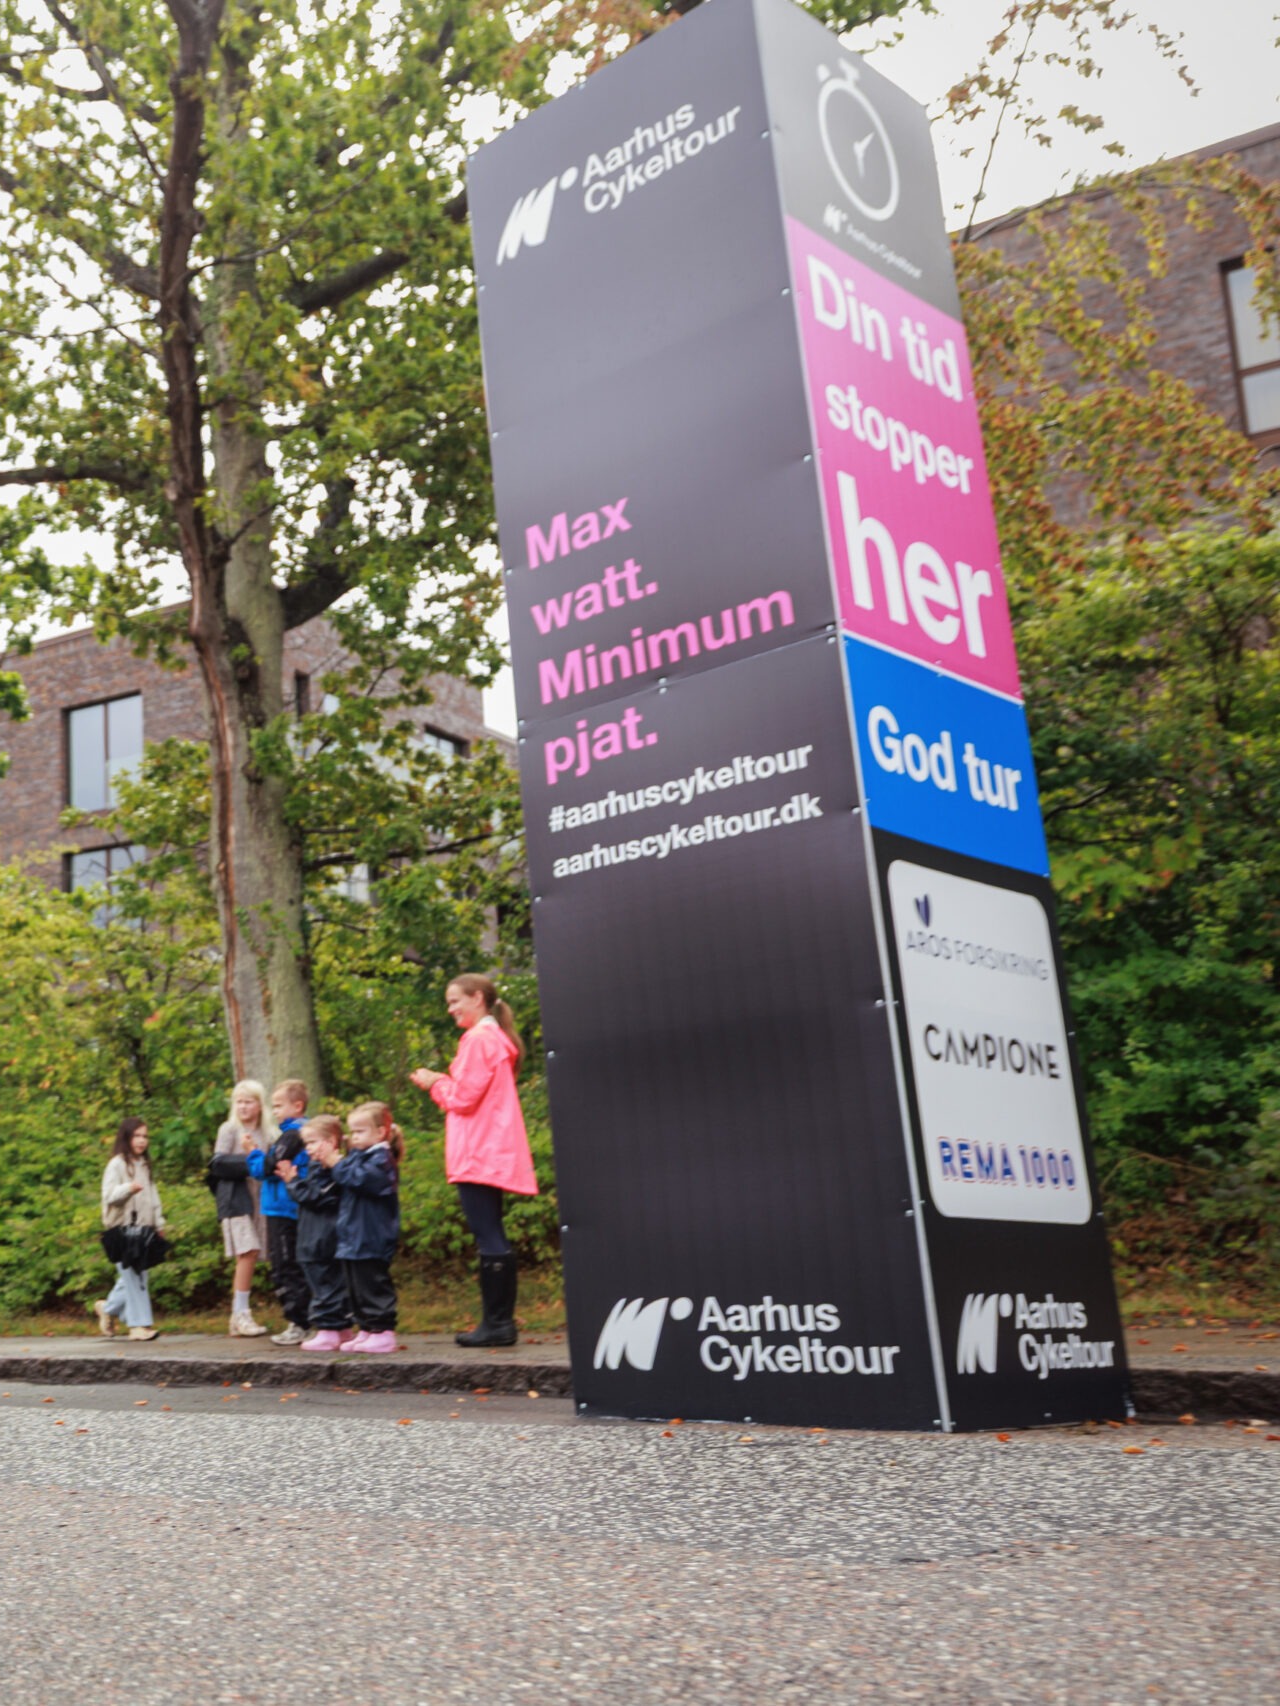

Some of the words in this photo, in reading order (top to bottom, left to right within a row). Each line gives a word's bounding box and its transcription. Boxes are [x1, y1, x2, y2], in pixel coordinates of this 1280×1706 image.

[582, 103, 695, 188] Aarhus
[584, 105, 741, 214] Cykeltour
[807, 254, 893, 362] Din
[900, 315, 964, 402] tid
[825, 384, 974, 494] stopper
[525, 497, 632, 570] Max
[837, 470, 993, 659] her
[530, 558, 659, 635] watt.
[538, 590, 795, 705] Minimum
[544, 706, 658, 786] pjat.
[867, 705, 958, 793] God
[963, 743, 1022, 811] tur
[548, 744, 814, 833] #aarhuscykeltour
[552, 793, 823, 878] aarhuscykeltour.dk
[906, 930, 953, 961] AROS
[924, 1023, 1061, 1079] CAMPIONE
[936, 1136, 1018, 1184] REMA
[1019, 1145, 1077, 1191] 1000
[698, 1296, 841, 1333] Aarhus
[1015, 1293, 1087, 1330] Aarhus
[700, 1335, 900, 1381] Cykeltour
[1018, 1334, 1116, 1379] Cykeltour
